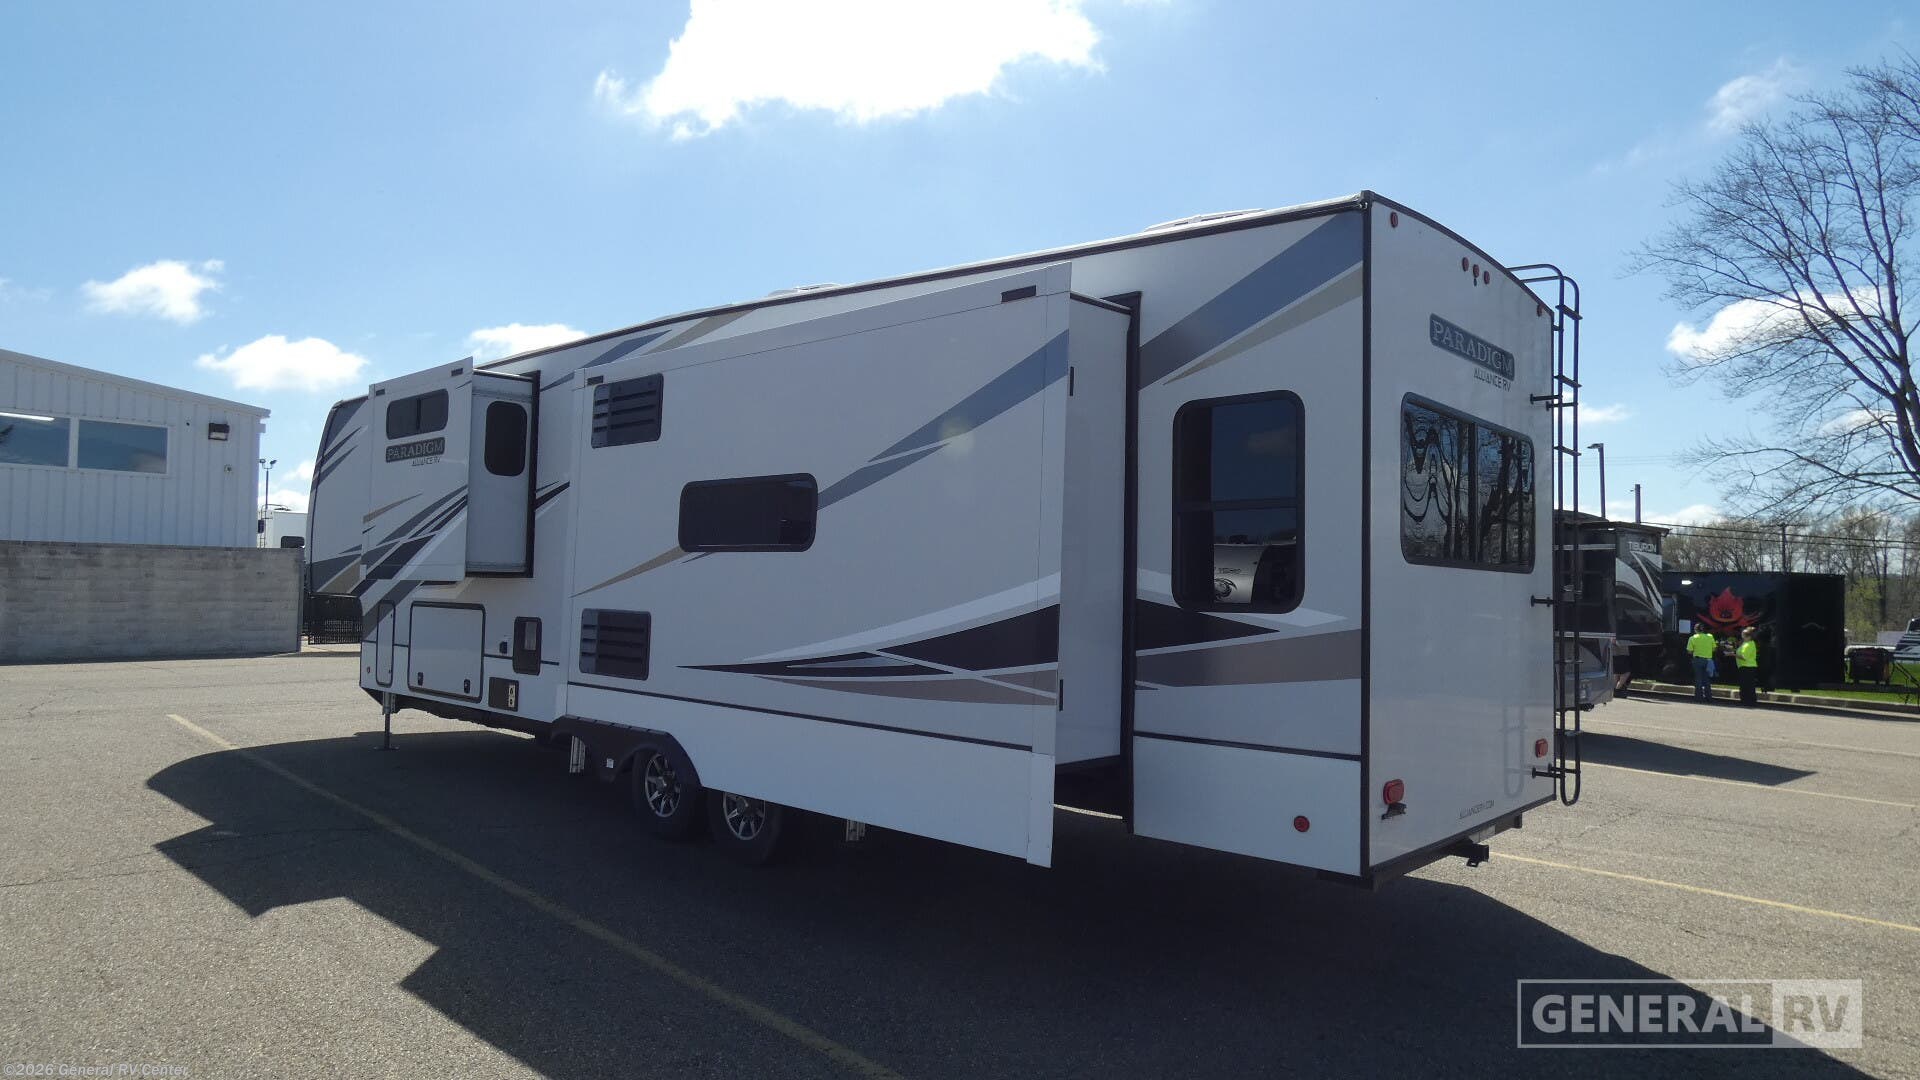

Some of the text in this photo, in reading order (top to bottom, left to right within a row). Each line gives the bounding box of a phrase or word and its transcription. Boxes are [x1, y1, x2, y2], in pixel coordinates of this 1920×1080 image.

[1431, 319, 1513, 376] PARADIGM
[1502, 378, 1512, 392] RV
[387, 439, 443, 460] PARADIGM
[1628, 541, 1657, 553] TIBURON
